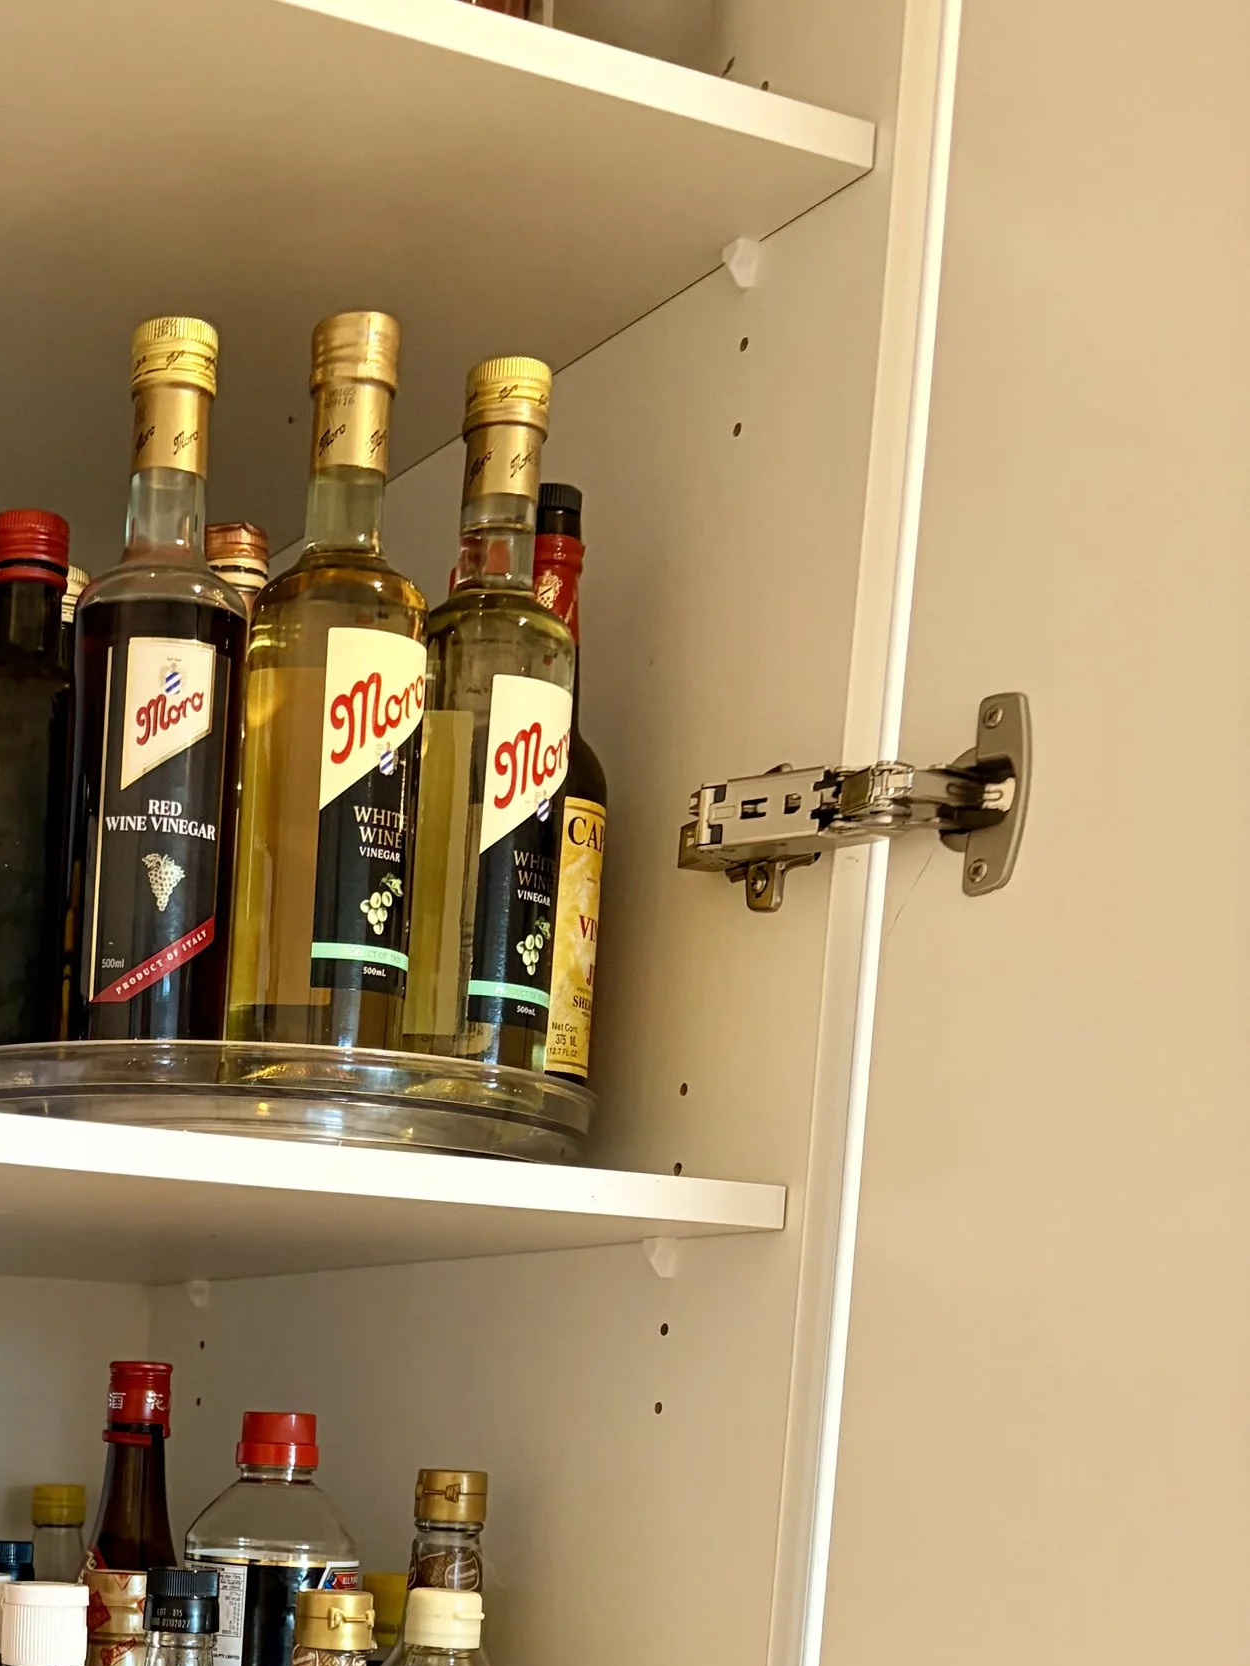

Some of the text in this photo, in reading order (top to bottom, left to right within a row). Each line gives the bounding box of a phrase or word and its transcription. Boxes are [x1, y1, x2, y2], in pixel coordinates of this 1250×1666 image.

[136, 692, 204, 746] Moro
[330, 672, 424, 765] Moro
[148, 799, 182, 817] RED
[105, 816, 216, 841] WINE VINEGAR
[359, 826, 403, 849] WINE
[359, 846, 400, 863] VINEGAR
[101, 958, 125, 969] 500ml
[115, 929, 207, 994] PRODUCT OF ITALY
[363, 966, 387, 978] 500mL
[516, 1005, 536, 1016] 500mL
